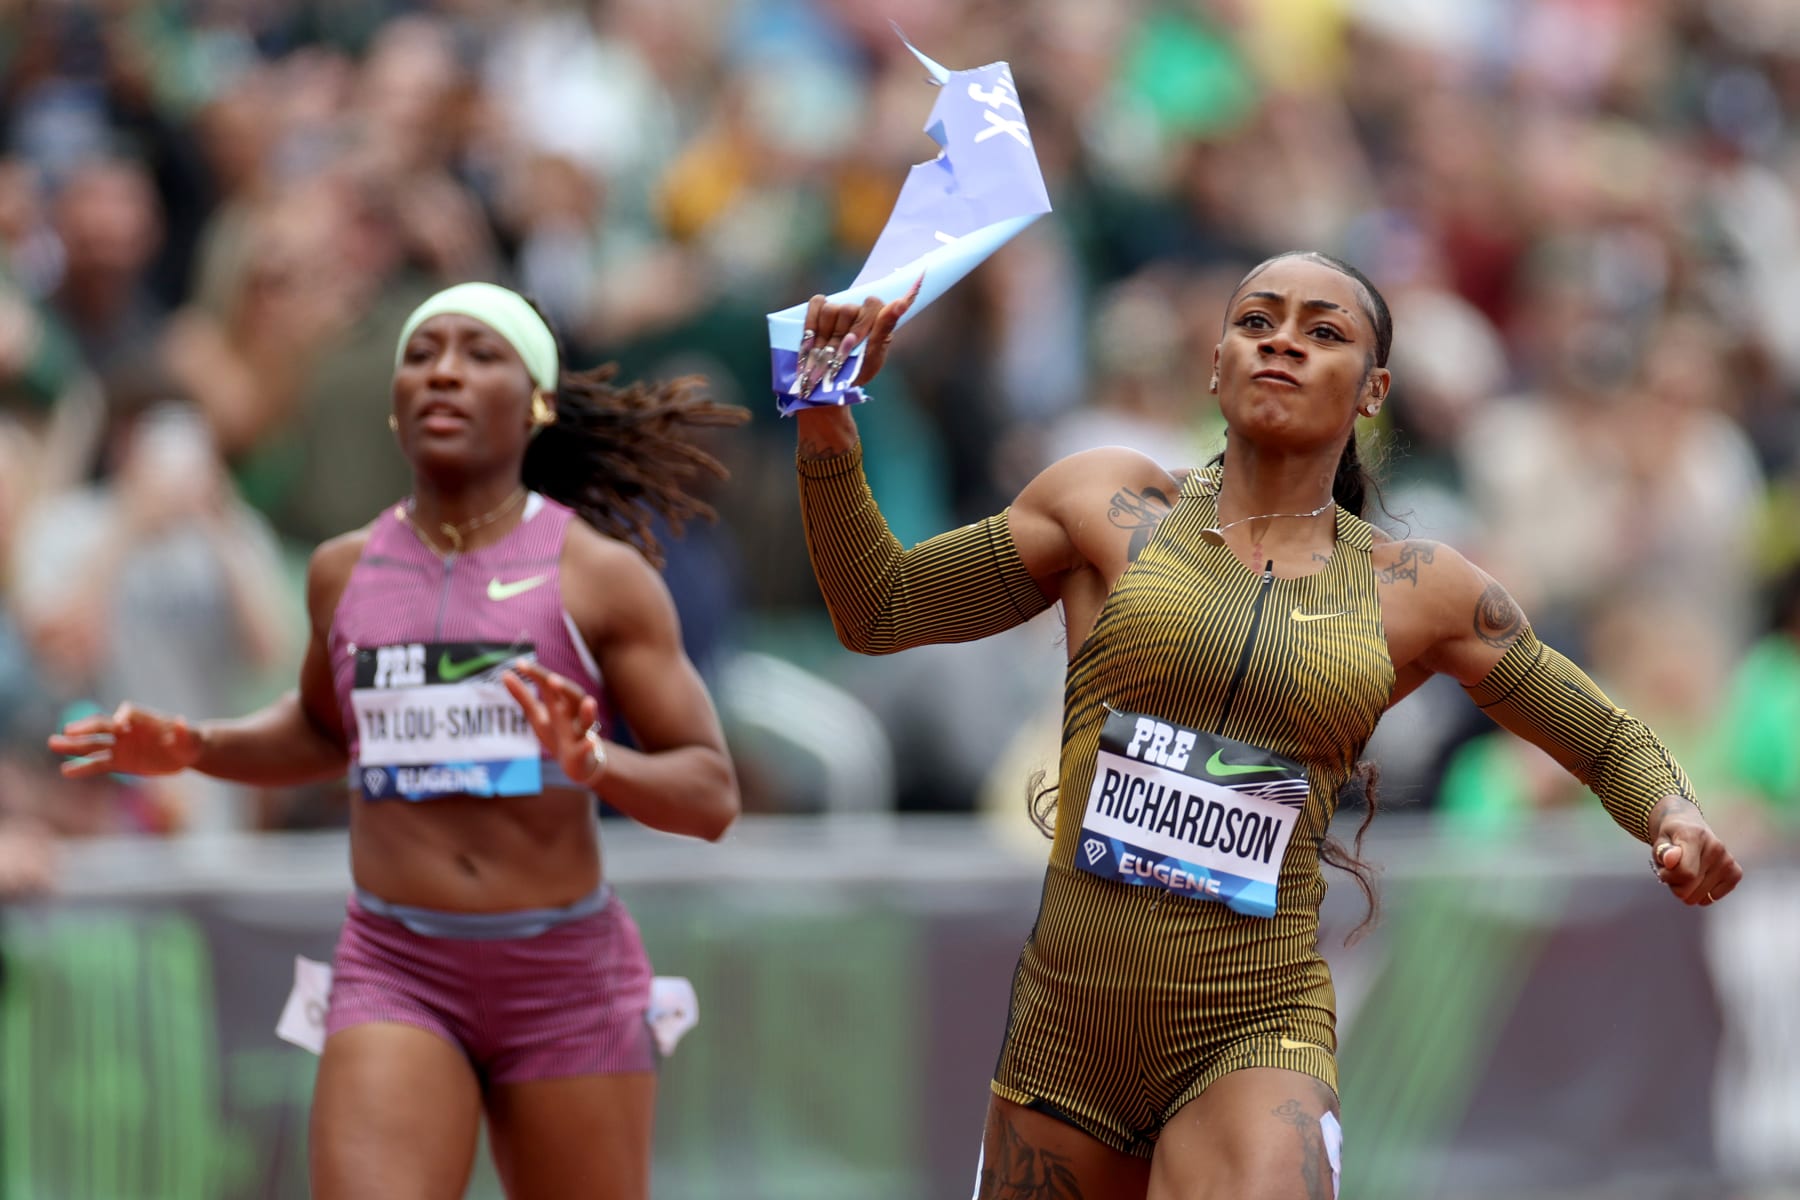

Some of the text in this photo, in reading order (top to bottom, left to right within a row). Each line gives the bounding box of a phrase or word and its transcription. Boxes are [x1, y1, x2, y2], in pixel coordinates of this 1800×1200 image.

[375, 644, 426, 689] PRE
[1127, 717, 1197, 771] PRE
[396, 765, 489, 794] EUGENE
[1096, 768, 1282, 864] RICHARDSON
[1118, 853, 1221, 897] EUGENE
